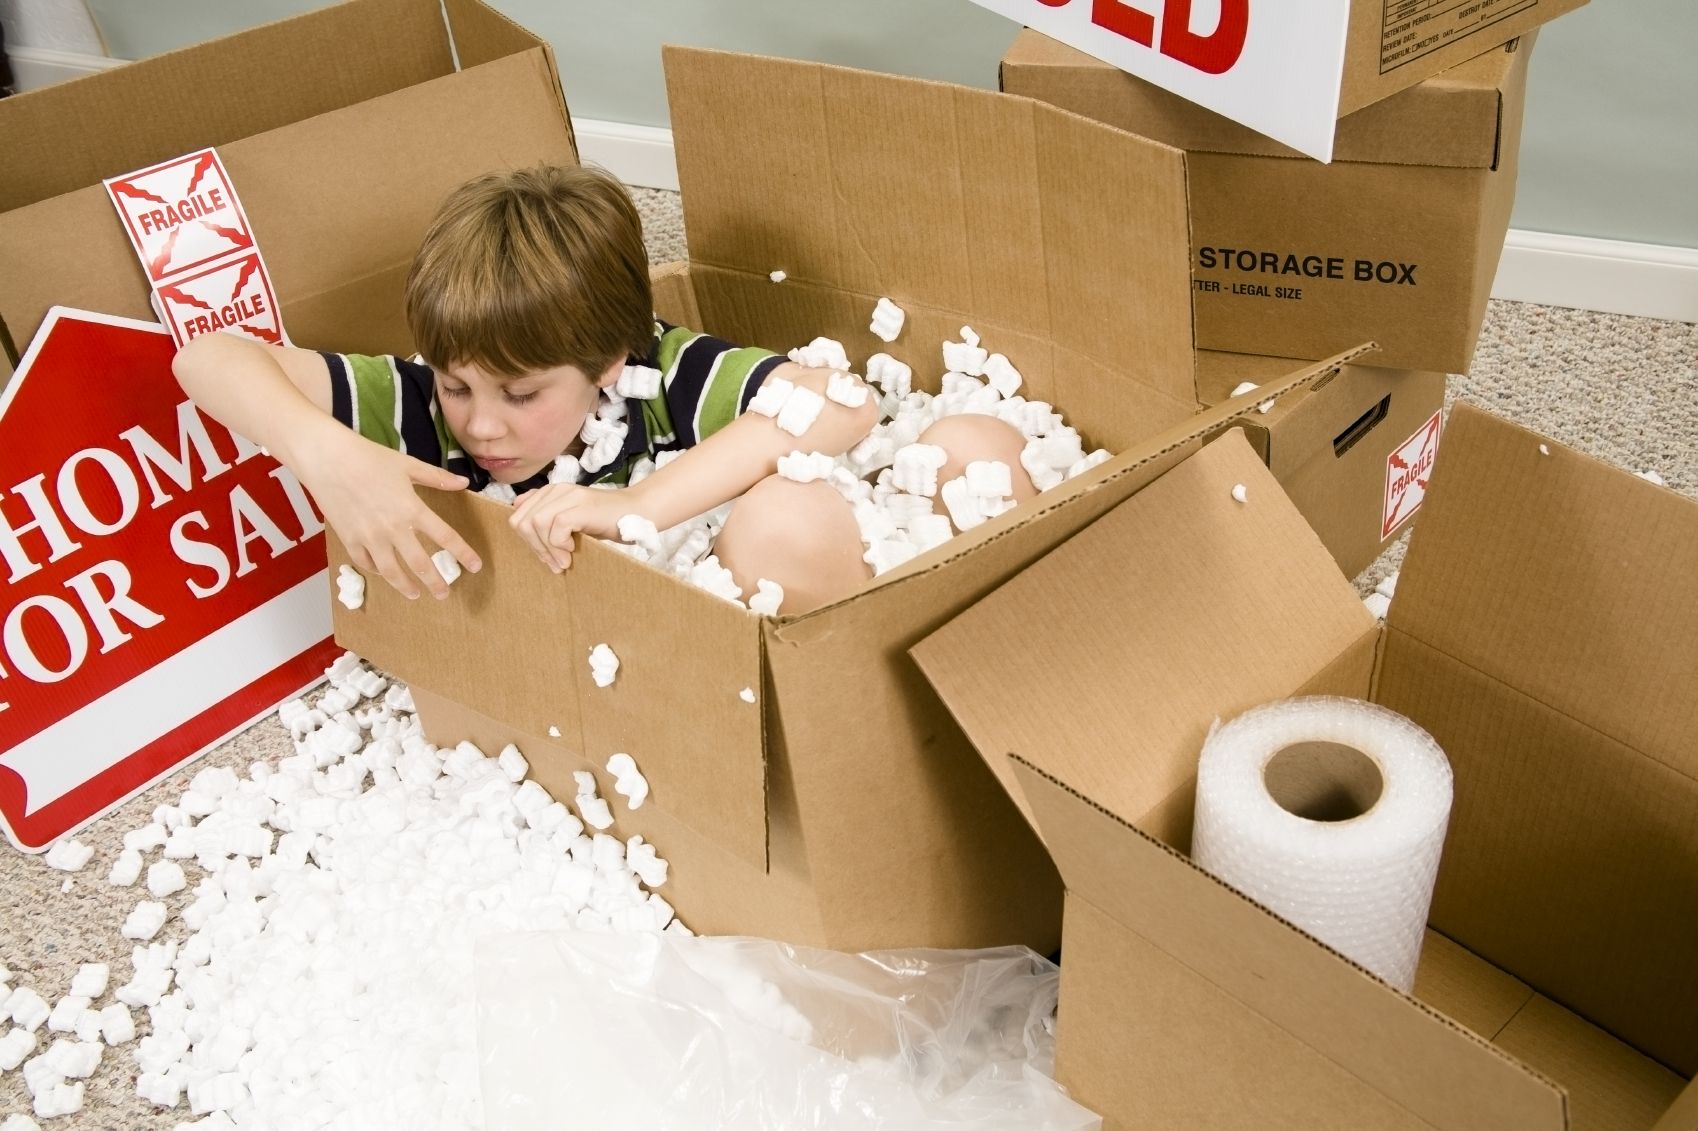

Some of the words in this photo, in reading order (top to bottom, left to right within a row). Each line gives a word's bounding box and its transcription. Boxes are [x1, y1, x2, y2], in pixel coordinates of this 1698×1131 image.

[1384, 22, 1411, 40] RETENTION
[1458, 4, 1481, 19] DESTROY
[1382, 39, 1401, 53] REVIEW
[138, 188, 227, 236] FRAGILE
[1199, 247, 1344, 279] STORAGE
[1354, 260, 1418, 286] BOX
[1232, 283, 1271, 297] LEGAL
[1275, 287, 1302, 300] SIZE
[183, 293, 266, 341] FRAGILE
[1391, 449, 1433, 500] FRAGILE
[0, 559, 166, 713] OR
[169, 465, 325, 599] SAL
